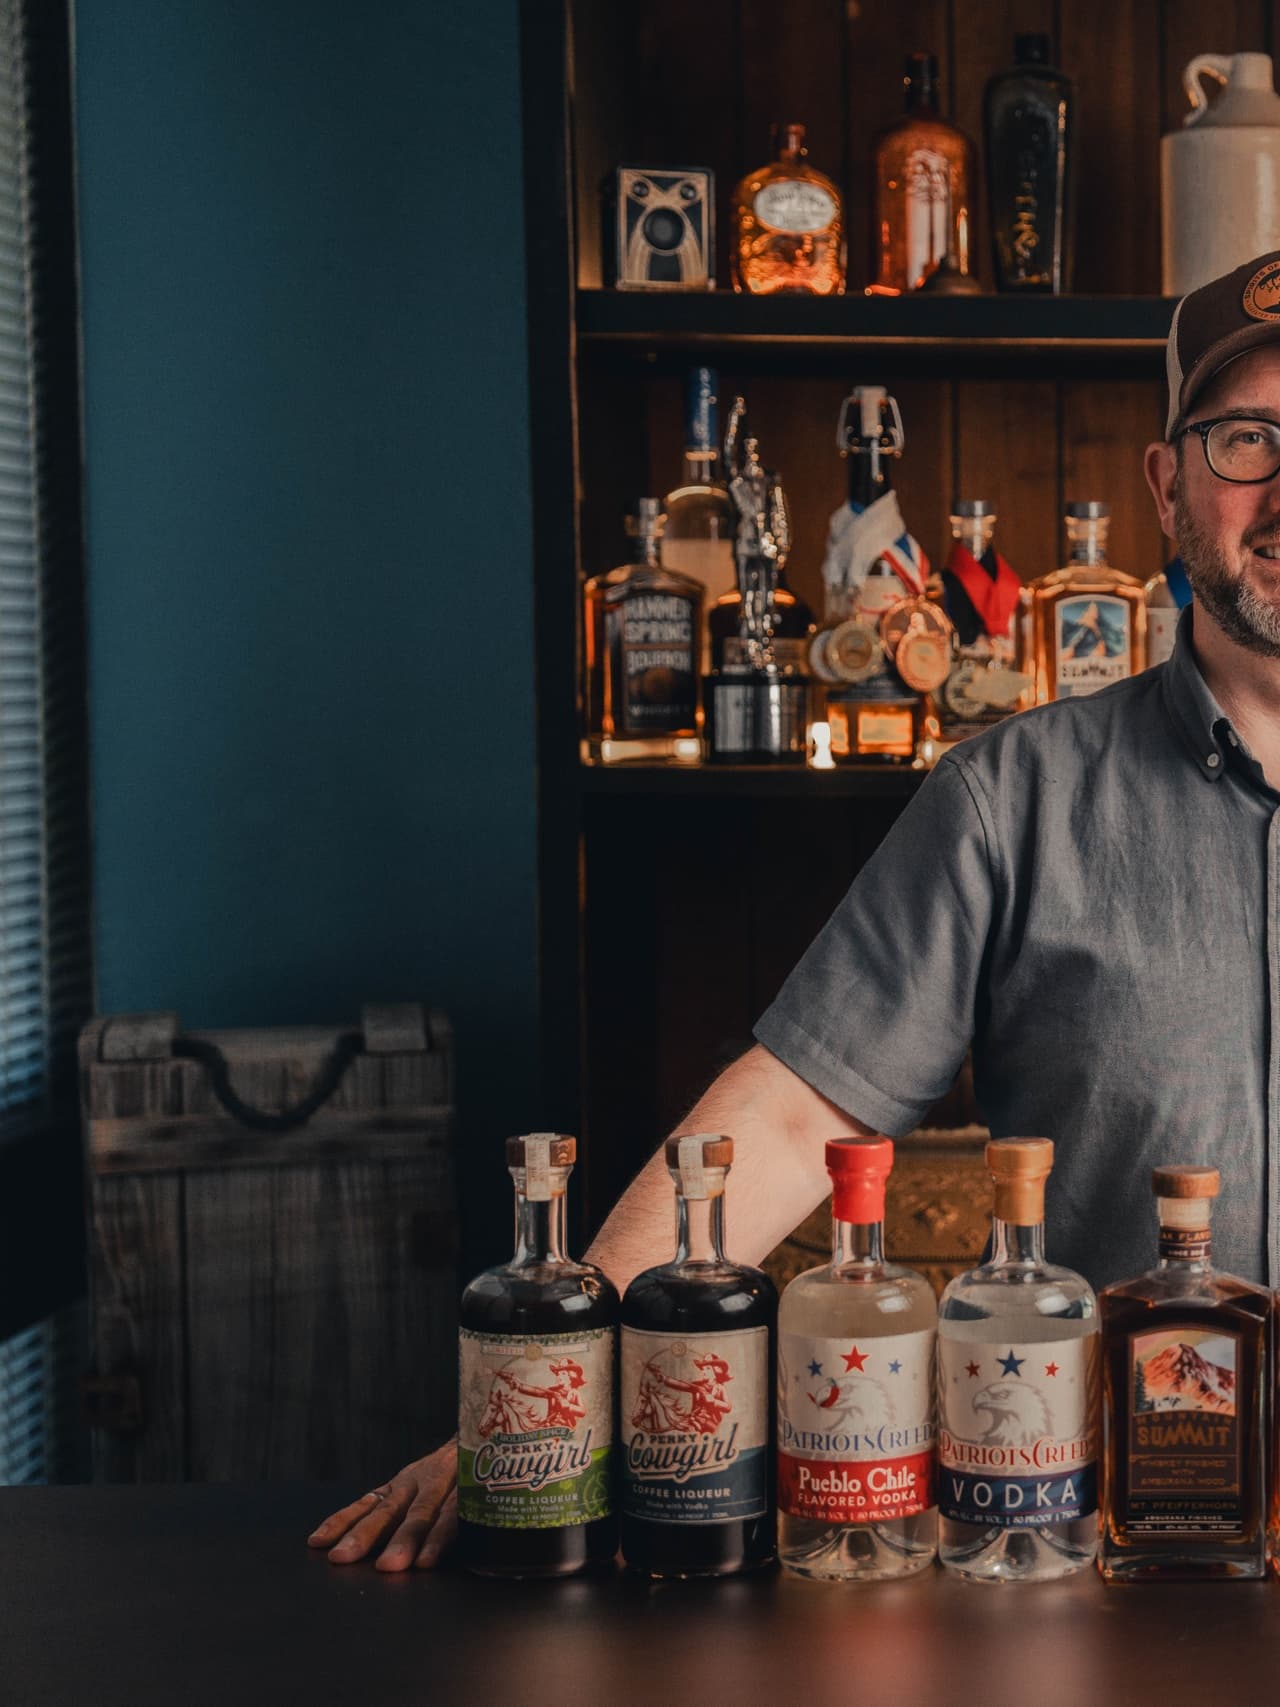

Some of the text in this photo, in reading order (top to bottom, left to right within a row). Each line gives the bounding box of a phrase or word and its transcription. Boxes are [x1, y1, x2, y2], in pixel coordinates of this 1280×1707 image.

[624, 595, 692, 620] HAMMER
[624, 621, 692, 643] SPRING
[626, 651, 691, 675] BOURBON
[649, 1434, 697, 1444] PERKY
[1137, 1422, 1231, 1447] SUMMIT
[475, 1429, 592, 1487] Cowgirl
[501, 1442, 554, 1455] PERKY
[630, 1422, 738, 1478] Cowgirl
[798, 1465, 917, 1493] Pueblo Chile
[486, 1494, 579, 1505] COFFEE LIQUEUR
[632, 1484, 731, 1499] COFFEE LIQUEUR
[798, 1490, 917, 1507] FLAVORED VODKA
[952, 1478, 1077, 1508] VODKA
